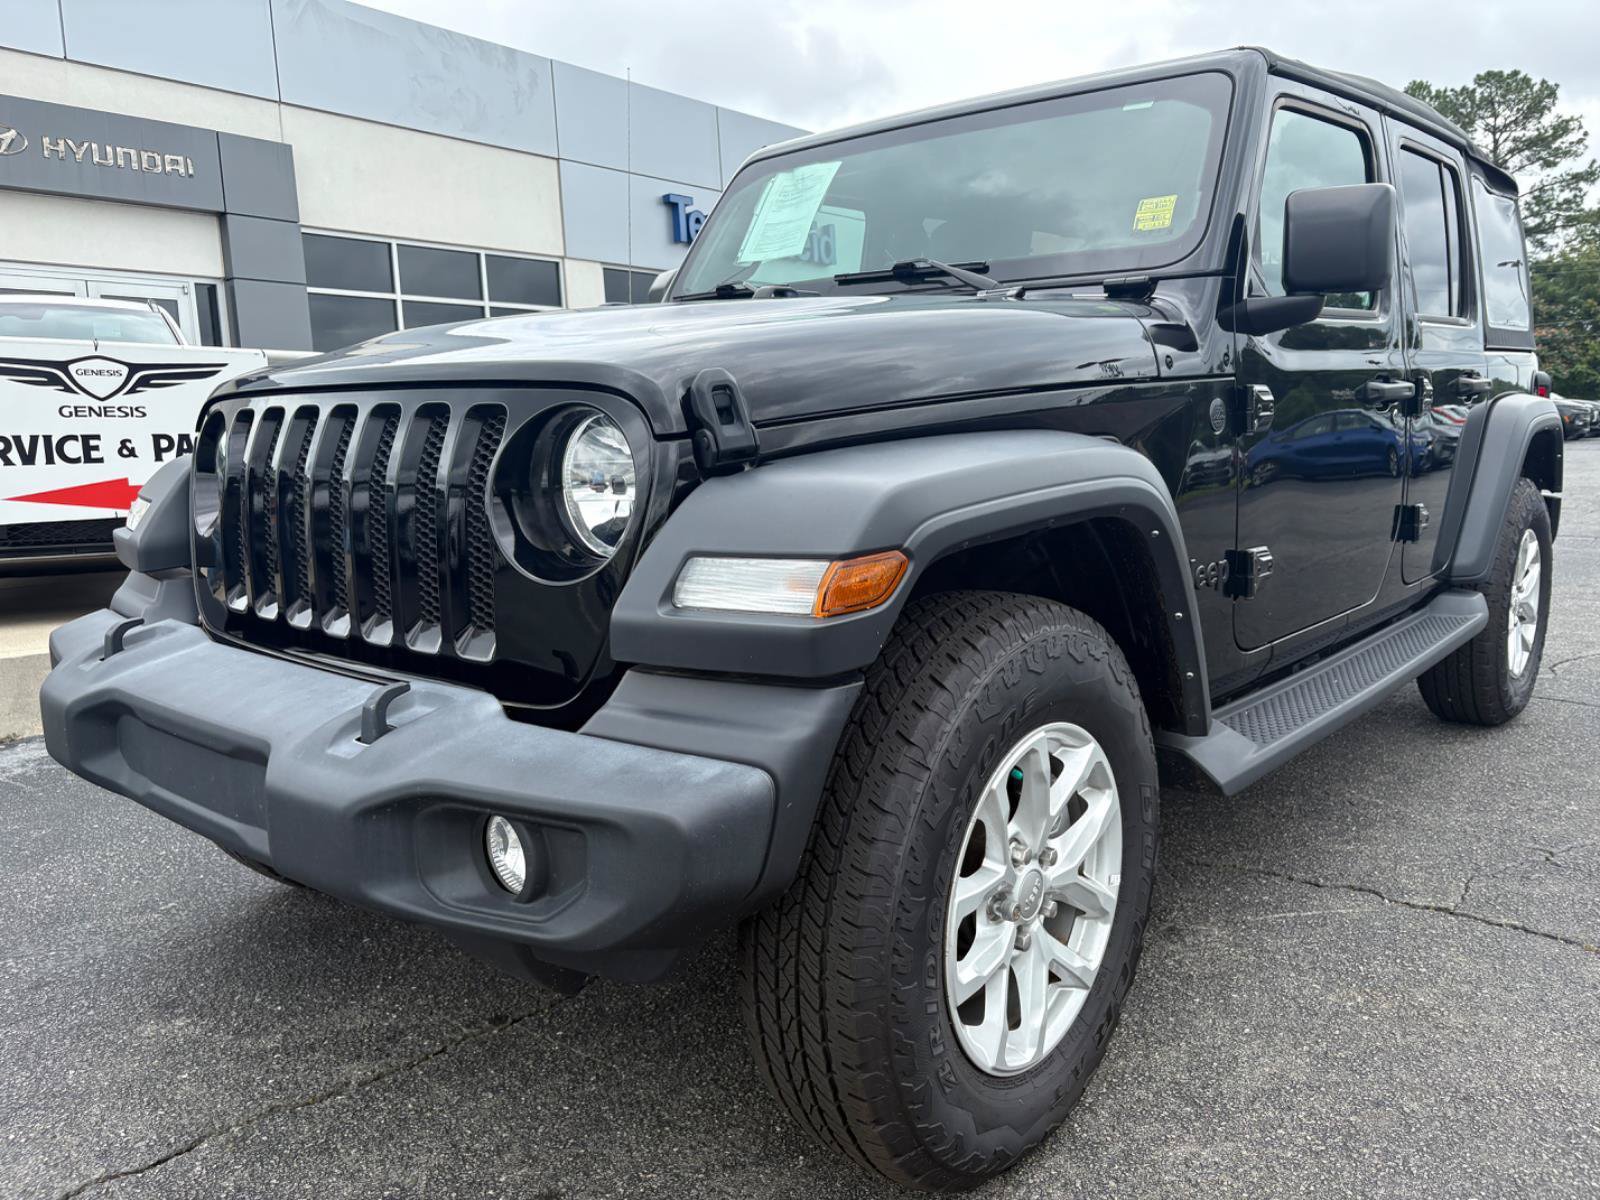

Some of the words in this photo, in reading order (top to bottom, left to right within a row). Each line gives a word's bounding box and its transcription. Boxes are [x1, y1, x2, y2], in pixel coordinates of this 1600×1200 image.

[41, 135, 195, 178] HYUNDAI
[75, 367, 123, 378] GENESIS
[58, 404, 148, 419] GENESIS
[117, 438, 139, 459] &
